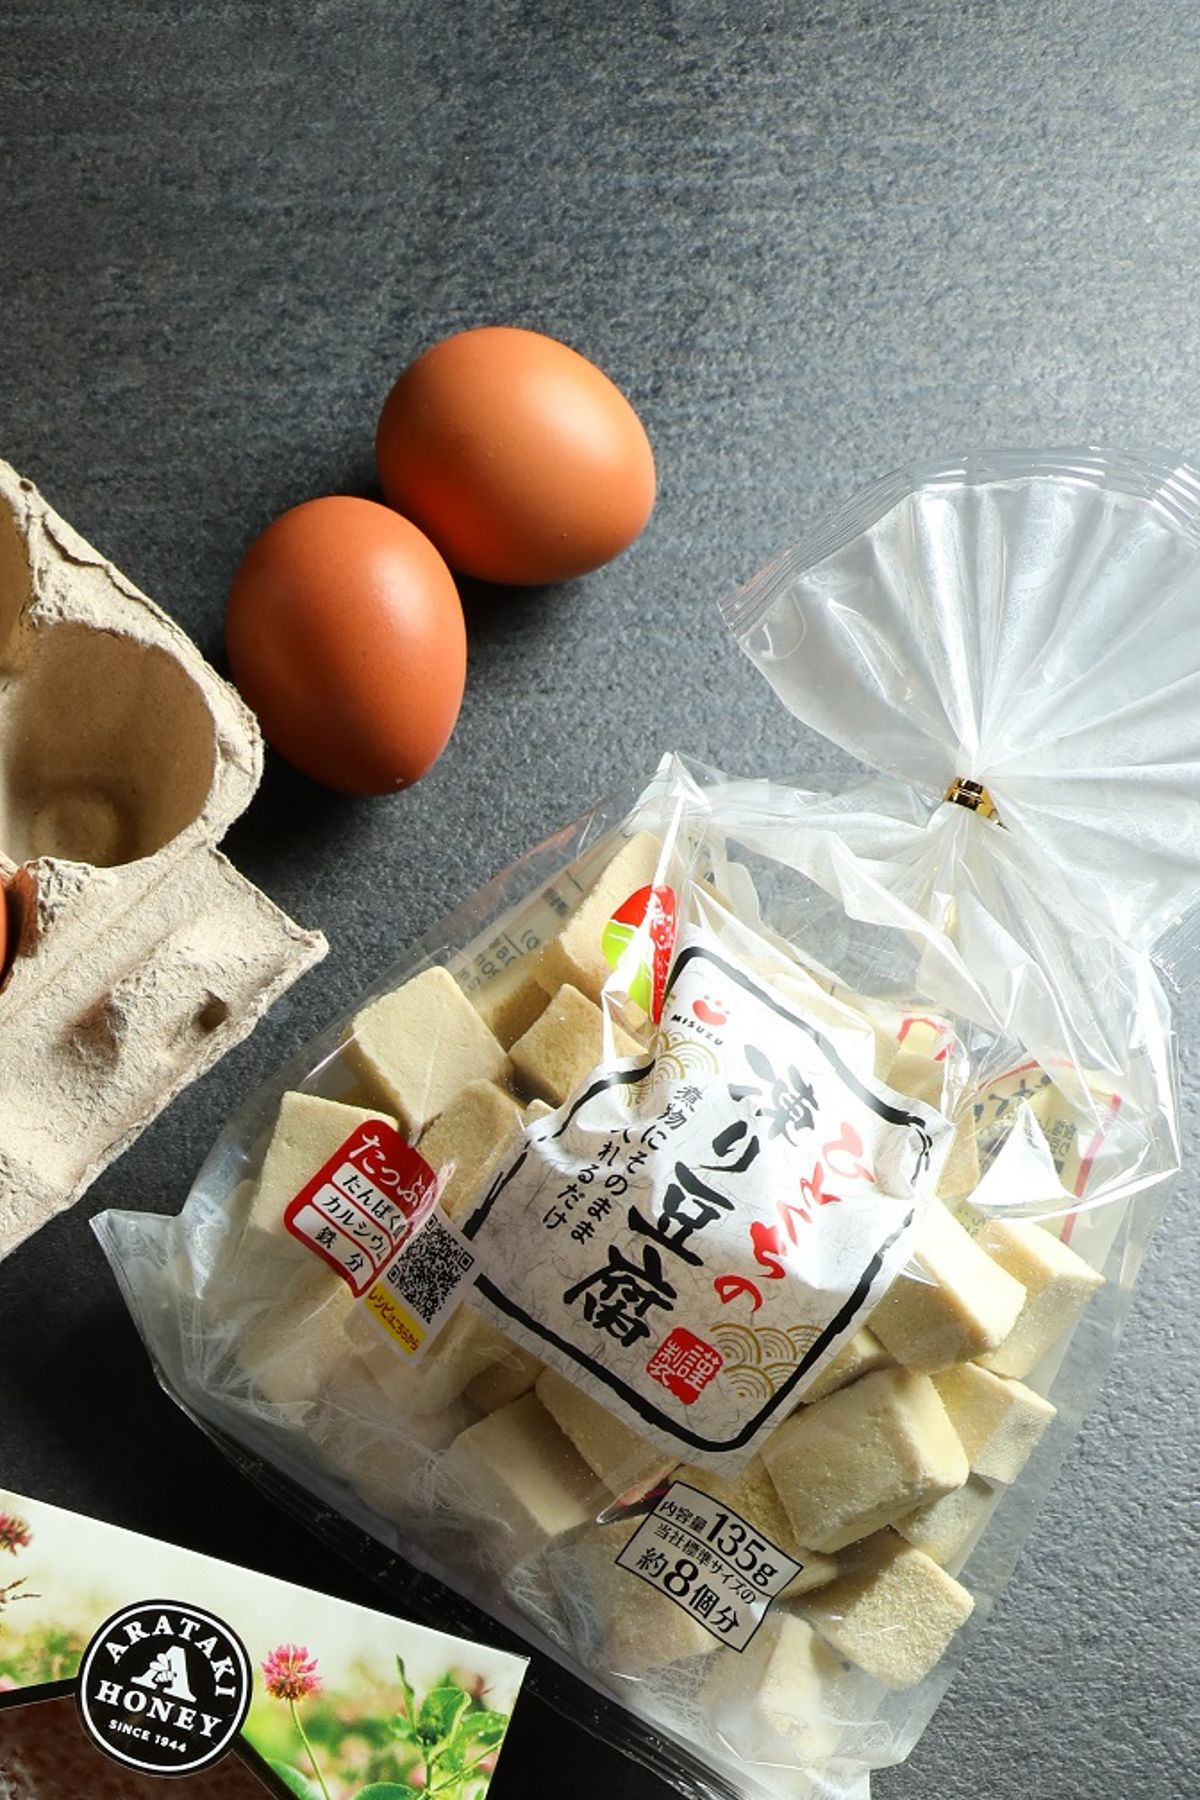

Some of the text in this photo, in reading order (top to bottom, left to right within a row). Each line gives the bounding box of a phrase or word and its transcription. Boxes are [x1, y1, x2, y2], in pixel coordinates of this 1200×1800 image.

[671, 1012, 724, 1047] MISUZU
[569, 1080, 703, 1246] 煮物にそのまま
[364, 1286, 421, 1351] レシピはこちらから
[634, 1543, 744, 1638] 約8個分
[652, 1521, 758, 1607] 当社標準サイズの
[107, 1614, 236, 1697] ARATAKI
[93, 1678, 222, 1739] HONEY
[108, 1718, 187, 1752] SINCE 1944
